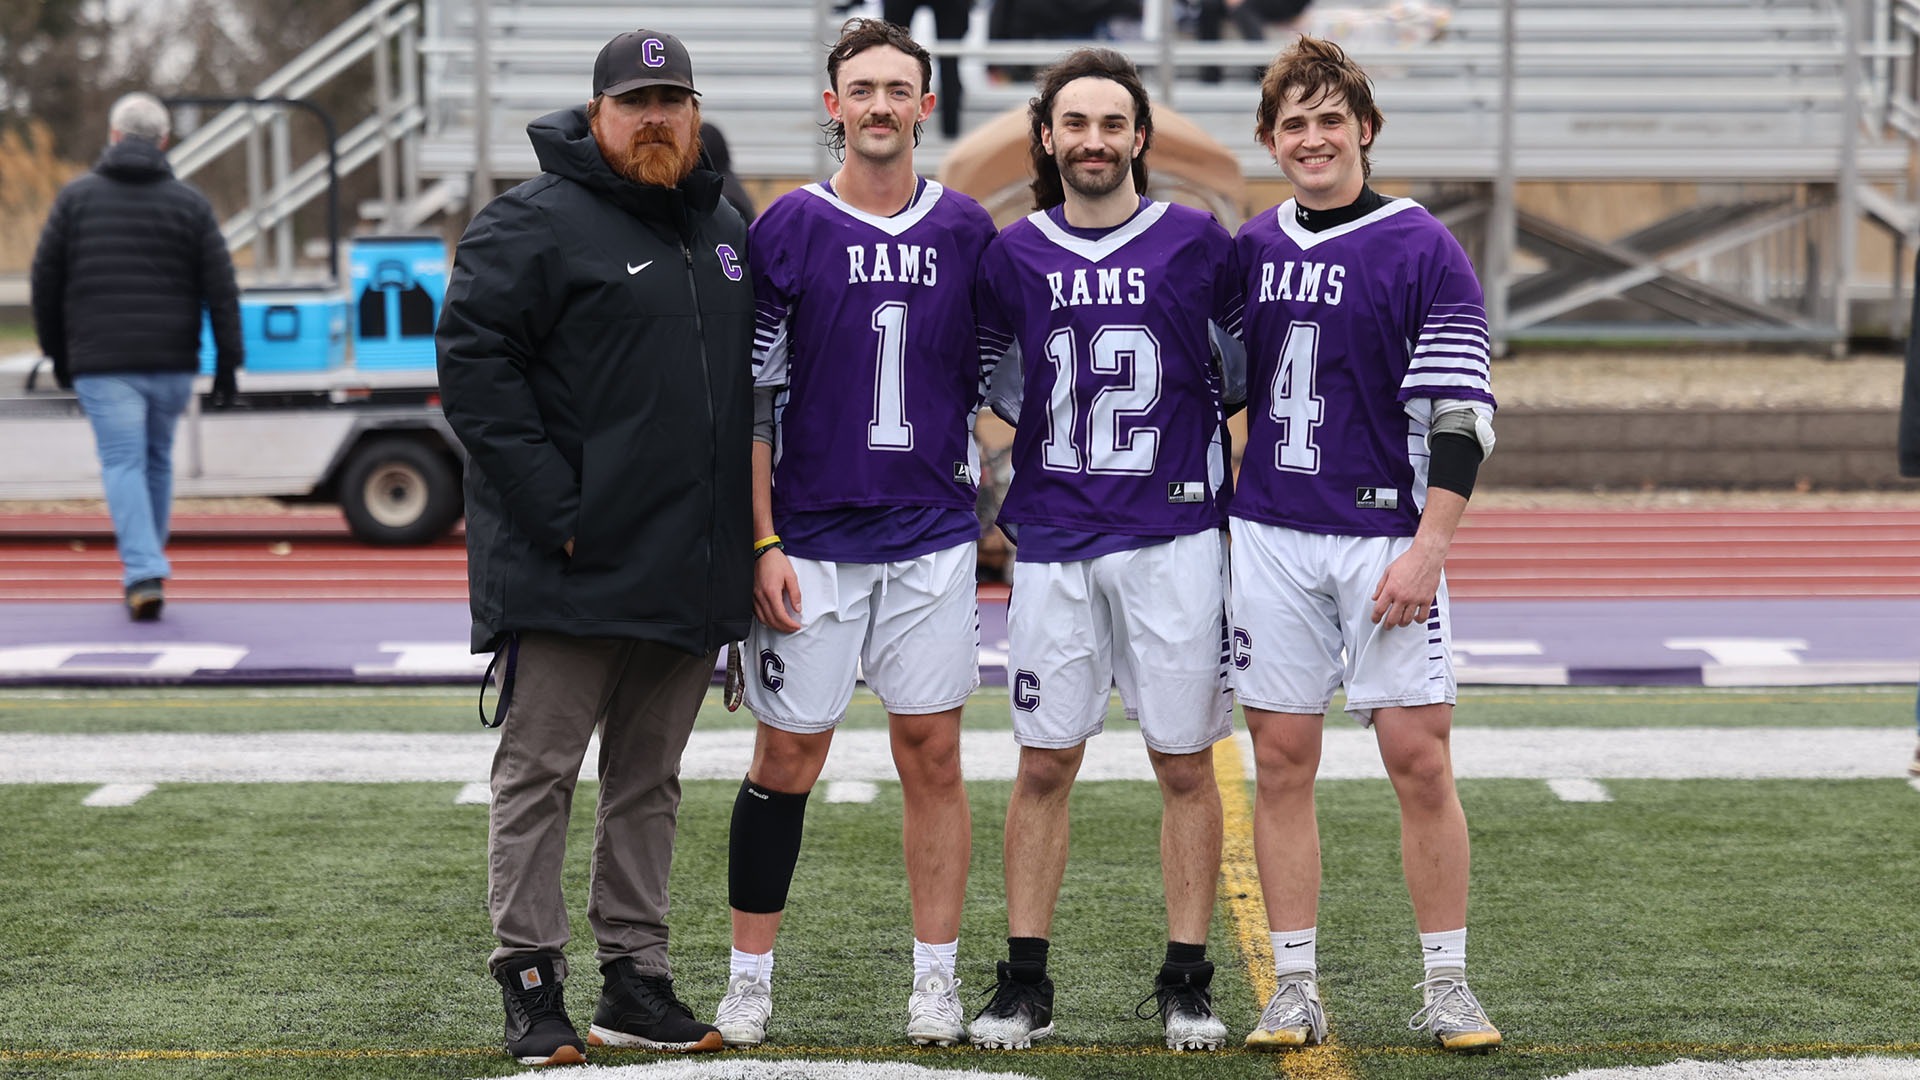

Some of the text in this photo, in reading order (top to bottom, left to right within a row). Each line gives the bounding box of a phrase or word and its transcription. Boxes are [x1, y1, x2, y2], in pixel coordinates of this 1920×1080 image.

[642, 38, 666, 68] C
[715, 244, 743, 282] C
[846, 243, 938, 287] RAMS
[1258, 261, 1346, 306] RAMS
[1046, 267, 1146, 311] RAMS
[868, 300, 914, 452] 1
[1269, 320, 1325, 475] 4
[1042, 324, 1163, 476] 12
[760, 648, 785, 694] C
[1233, 626, 1252, 671] C
[1013, 668, 1041, 713] C
